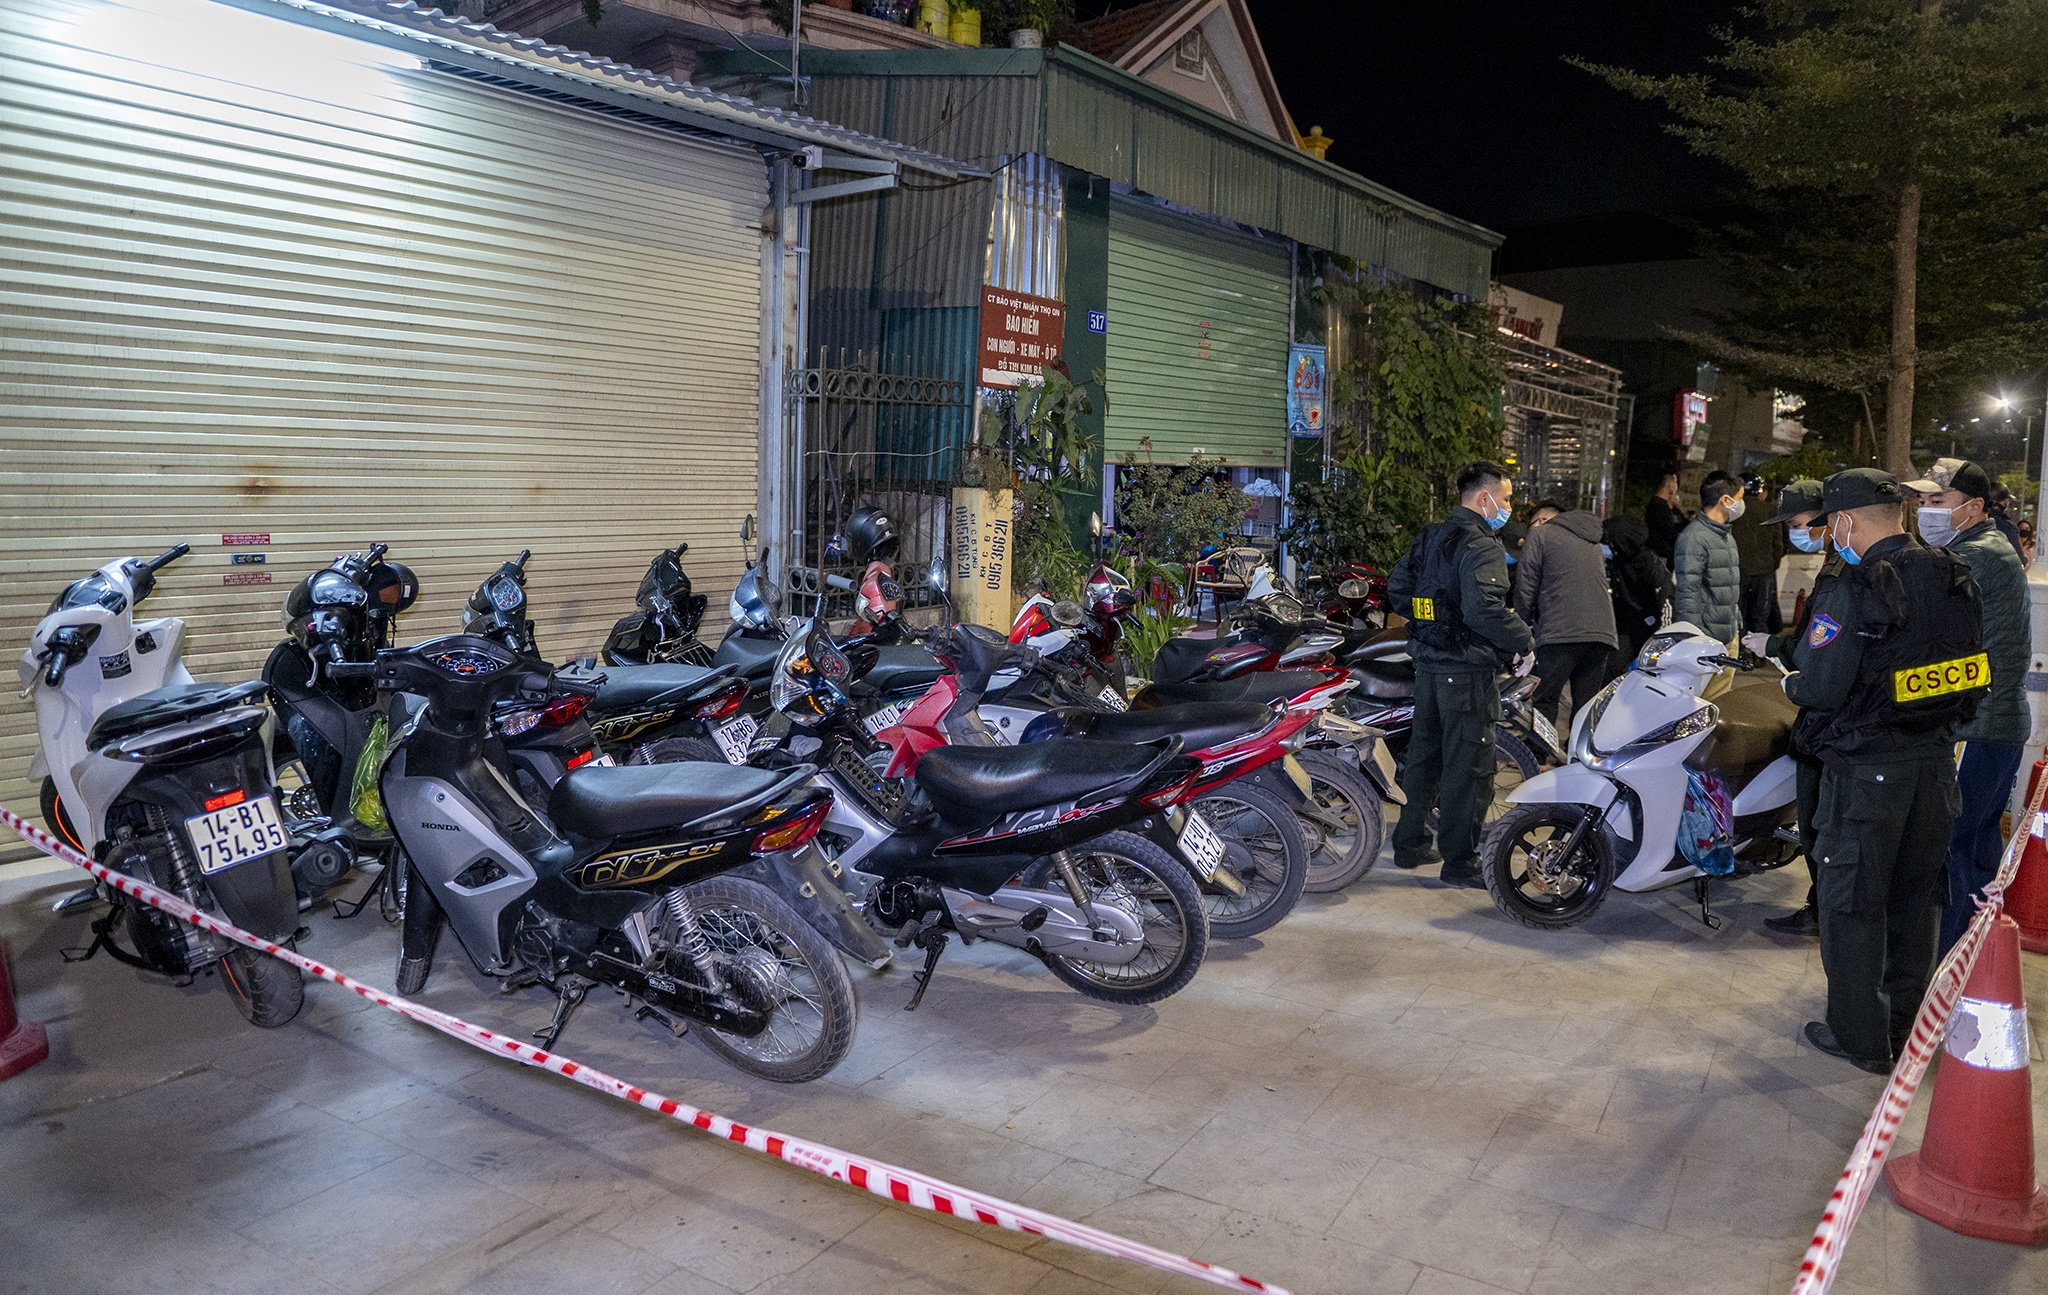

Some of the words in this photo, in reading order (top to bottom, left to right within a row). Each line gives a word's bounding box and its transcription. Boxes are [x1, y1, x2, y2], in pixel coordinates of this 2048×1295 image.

[987, 294, 995, 303] CT
[996, 295, 1009, 306] BẢO
[1009, 299, 1022, 310] VIỆT
[1040, 305, 1052, 317] THỌ
[1005, 308, 1021, 332] BẢO
[1021, 311, 1040, 336] HIỂM
[1090, 313, 1105, 330] 517
[987, 337, 998, 352] CON
[1020, 342, 1028, 357] XE
[1028, 341, 1041, 359] MÁY
[1045, 343, 1050, 360] Ô
[1050, 344, 1058, 361] TÔ
[1008, 361, 1019, 372] THỊ
[1020, 363, 1032, 374] KIM
[970, 513, 976, 525] KH
[980, 566, 986, 578] KH
[1905, 661, 1980, 694] CSCĐ
[720, 719, 753, 745] 17B6
[202, 801, 265, 840] 14-B1
[421, 821, 462, 832] HONDA
[200, 822, 283, 869] 754.95
